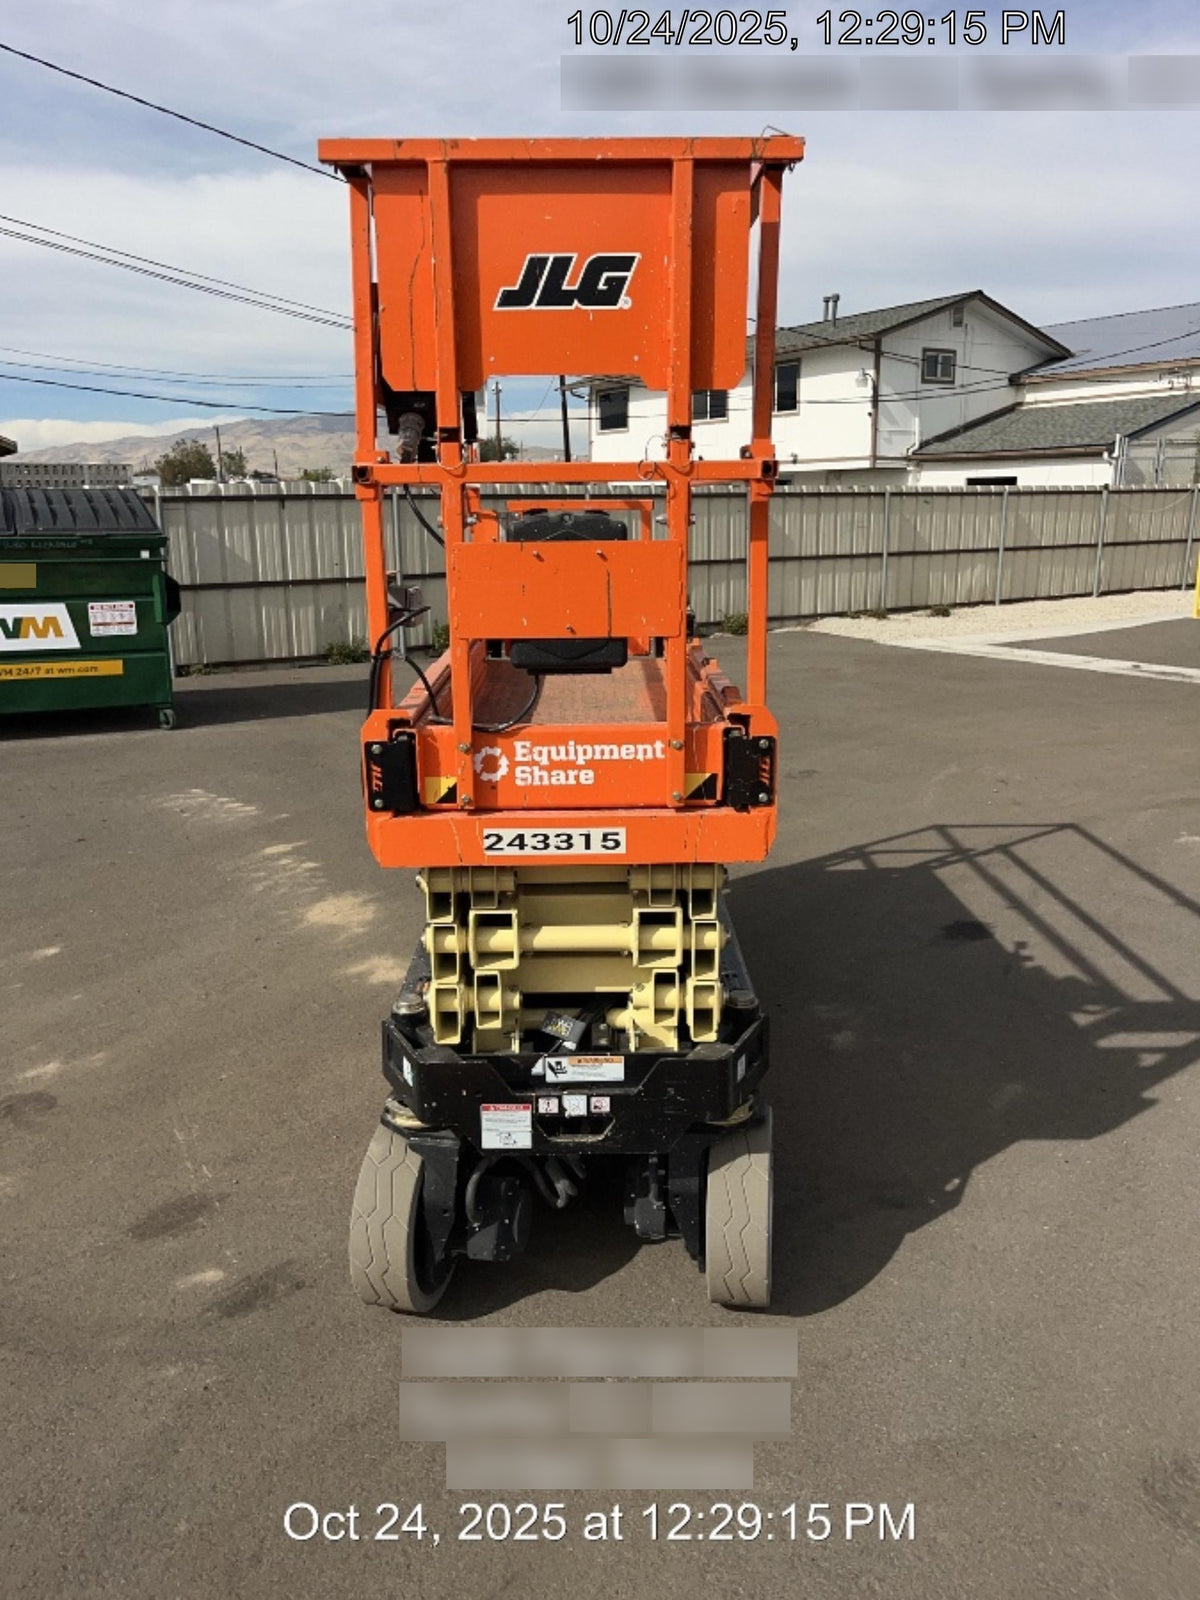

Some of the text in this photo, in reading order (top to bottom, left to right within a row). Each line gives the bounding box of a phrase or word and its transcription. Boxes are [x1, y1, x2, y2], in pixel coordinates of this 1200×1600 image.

[493, 252, 641, 311] JLG
[513, 740, 665, 765] Equipment
[514, 766, 595, 787] Share
[484, 831, 622, 851] 243315
